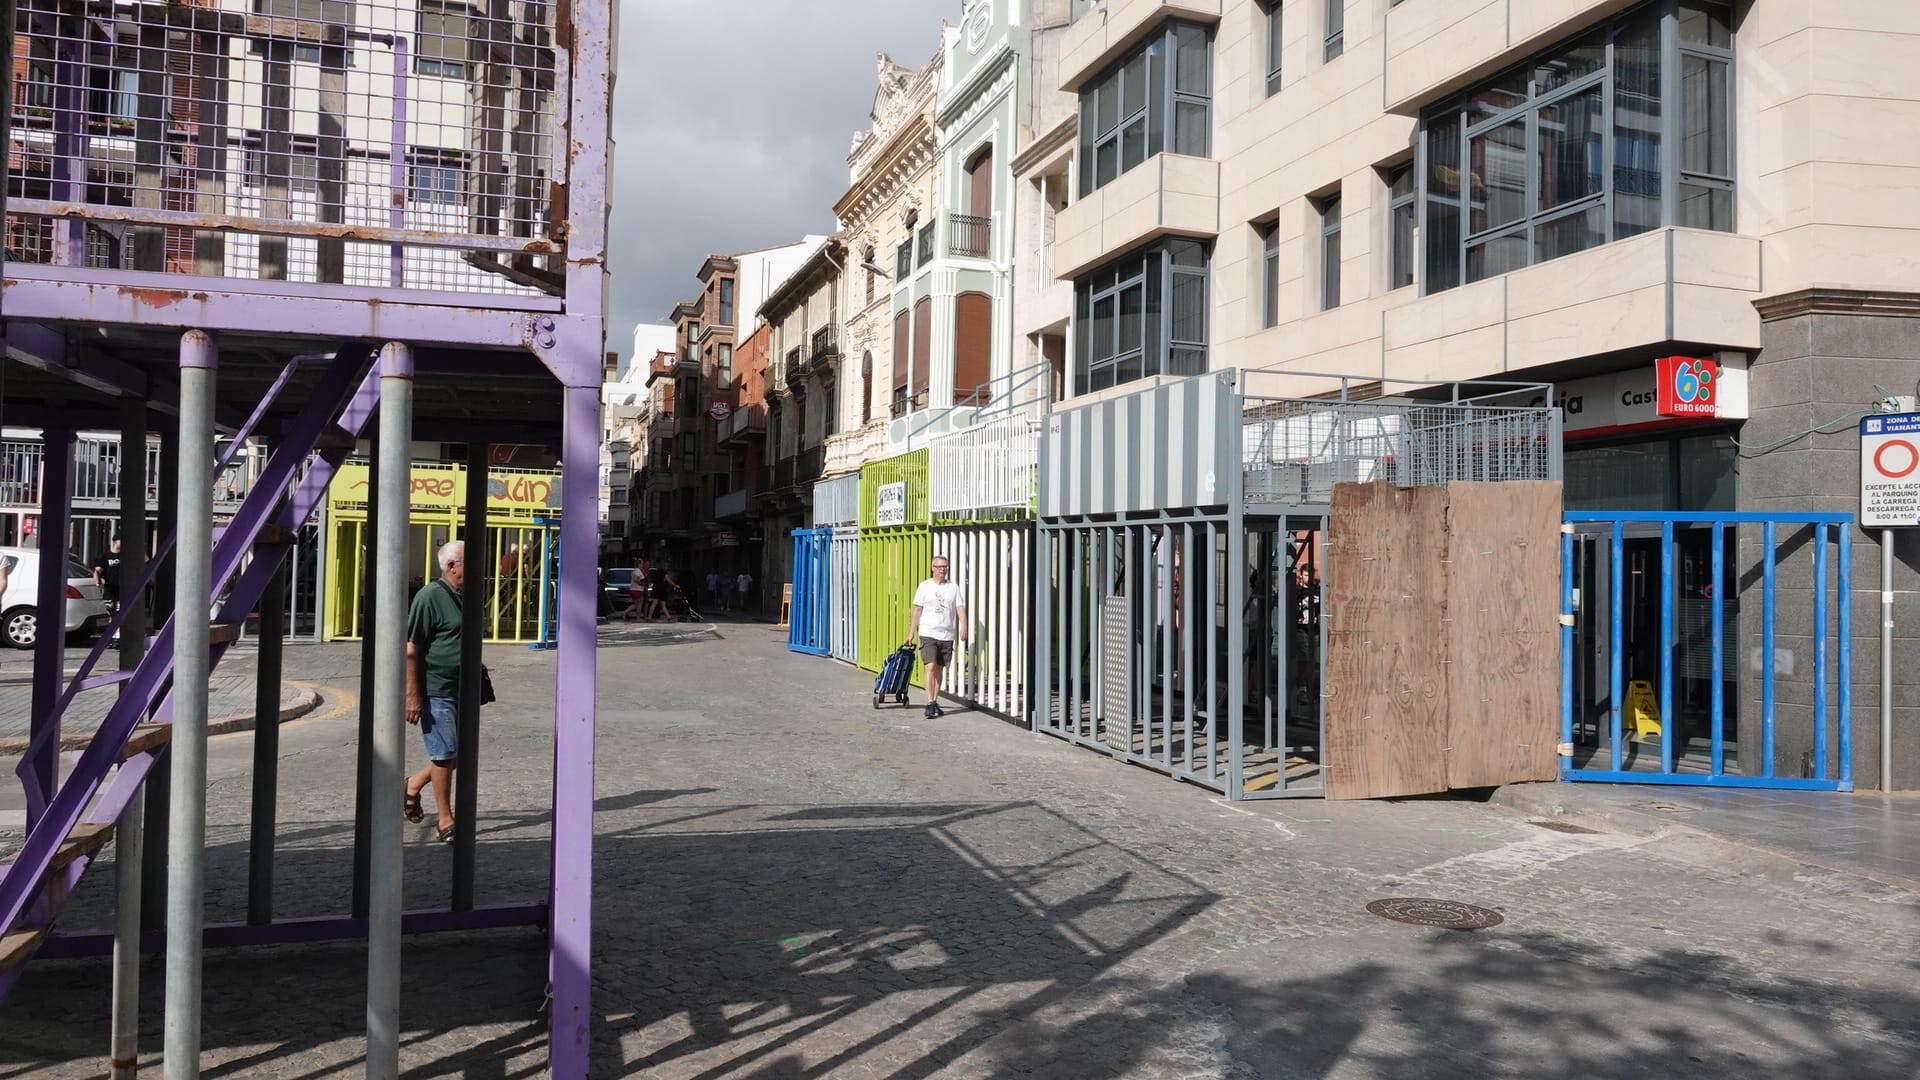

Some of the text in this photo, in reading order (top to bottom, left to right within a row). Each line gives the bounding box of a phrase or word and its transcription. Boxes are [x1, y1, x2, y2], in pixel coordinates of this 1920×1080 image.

[1674, 403, 1715, 413] EURO 6000
[1883, 490, 1918, 498] PARQUING
